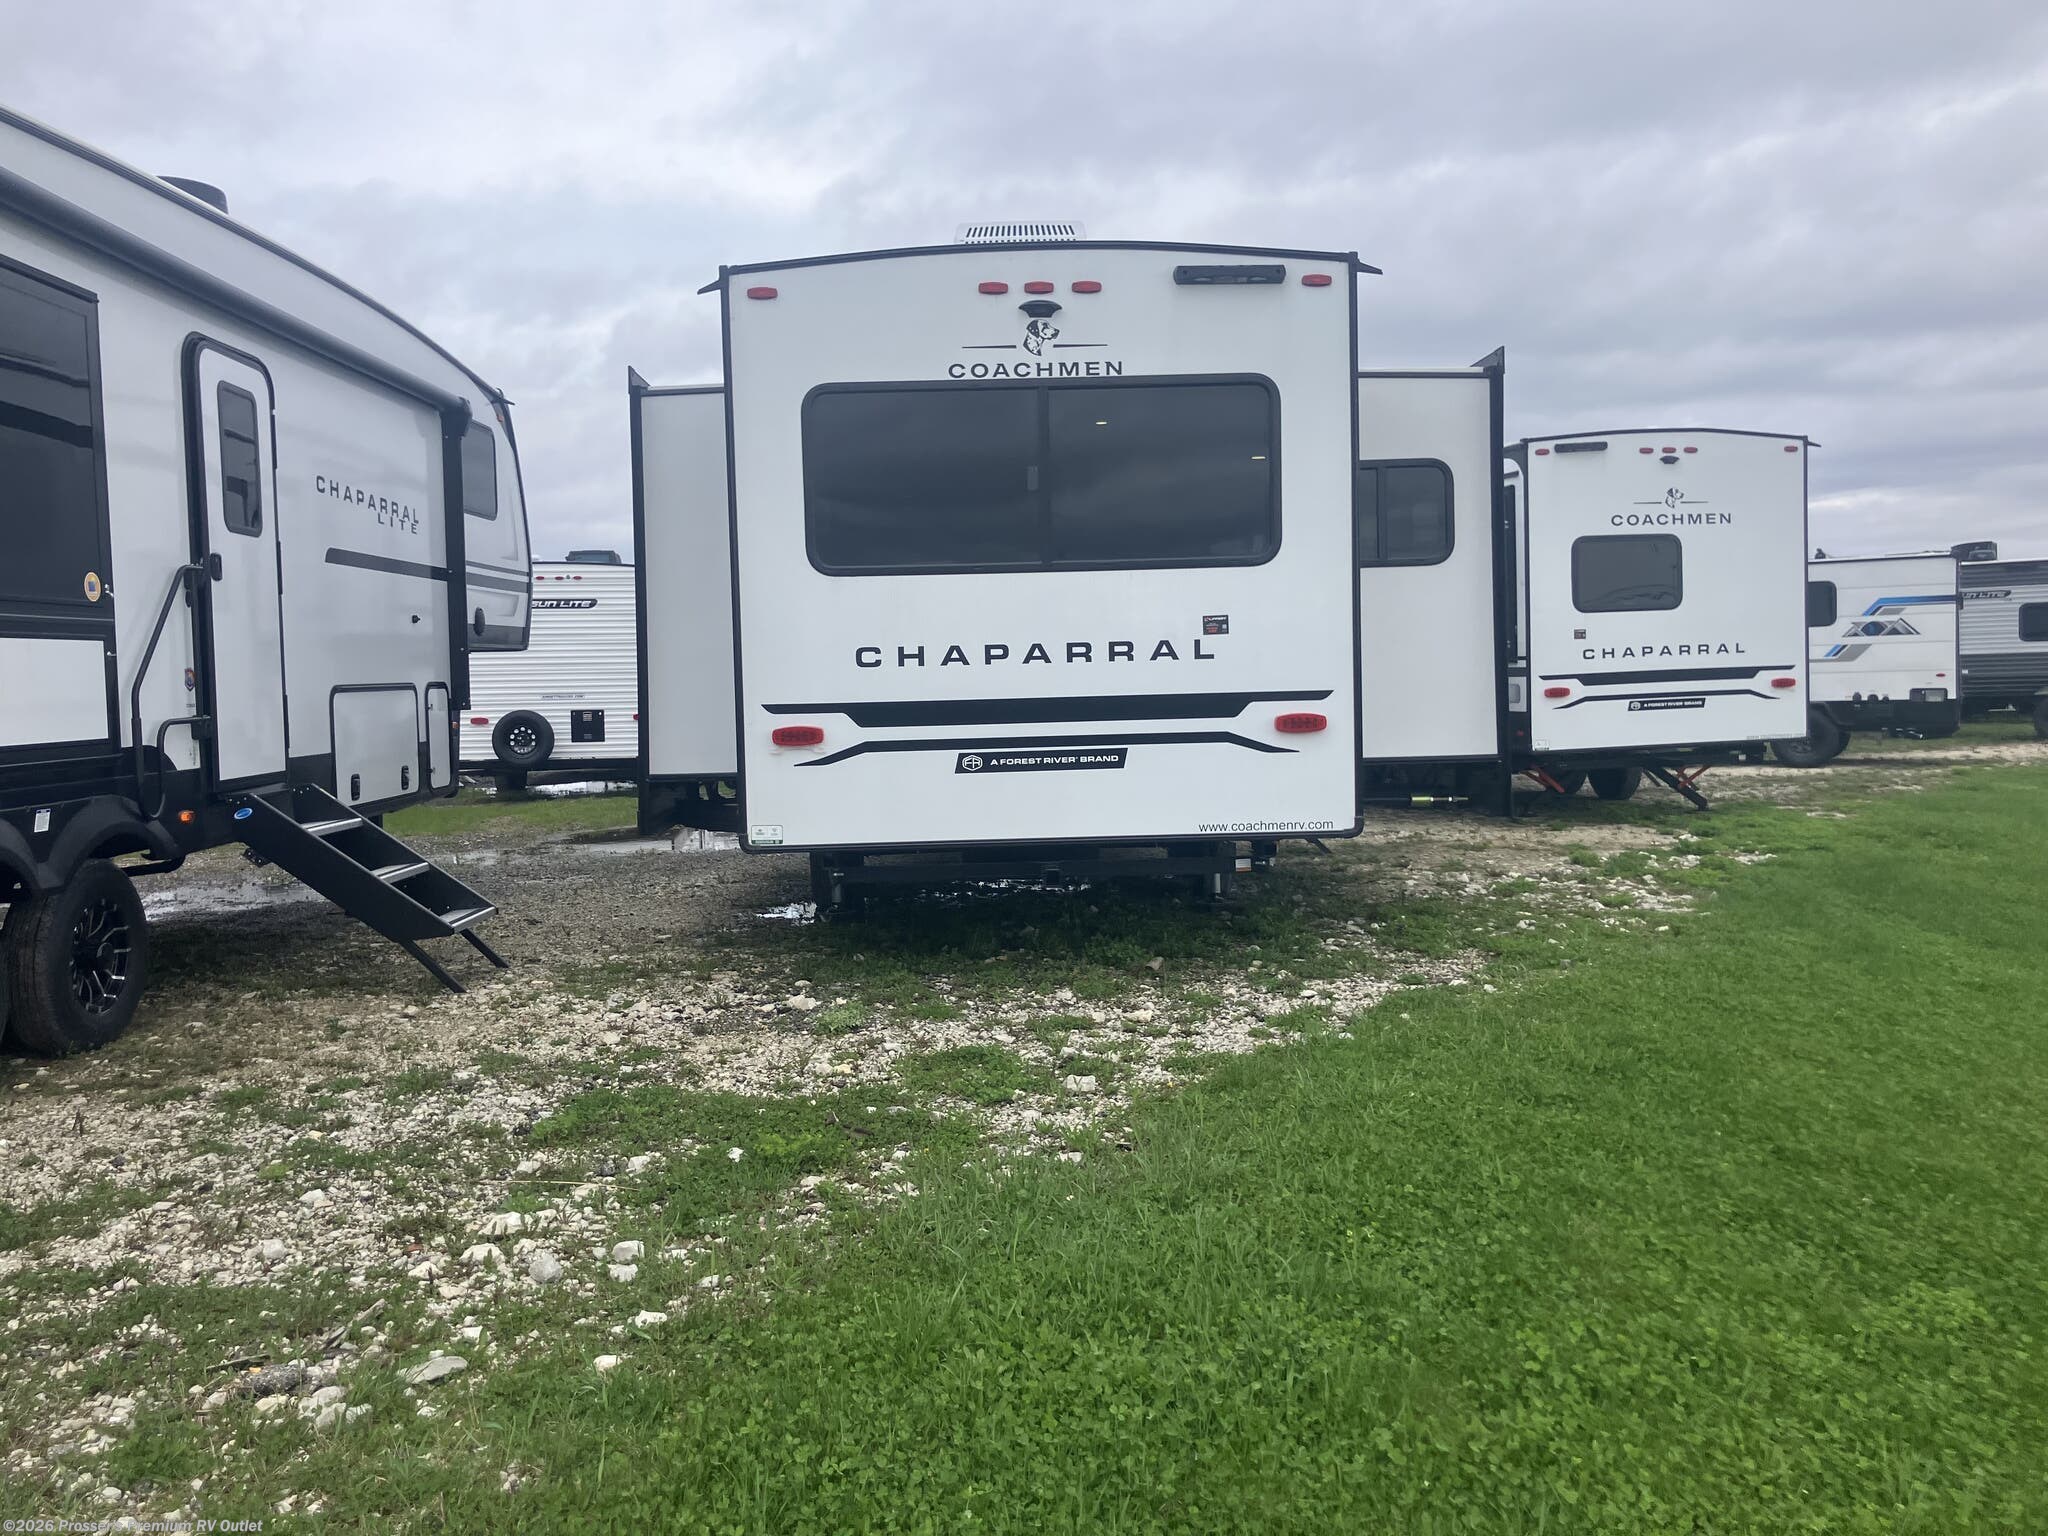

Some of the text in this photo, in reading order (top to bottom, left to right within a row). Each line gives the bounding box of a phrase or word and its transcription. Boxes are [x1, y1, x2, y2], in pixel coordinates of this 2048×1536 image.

[948, 360, 1123, 379] COACHMEN
[316, 475, 419, 524] CHAPARRAL
[377, 512, 418, 535] LITE
[1610, 512, 1732, 527] COACHMEN
[559, 600, 592, 608] LITE
[855, 638, 1215, 668] CHAPARRAL
[1582, 642, 1746, 660] CHAPARRAL
[990, 758, 999, 766] A
[1000, 757, 1042, 766] FOREST
[1080, 755, 1119, 763] BRAND
[1198, 820, 1334, 832] www.coachmenrv.com
